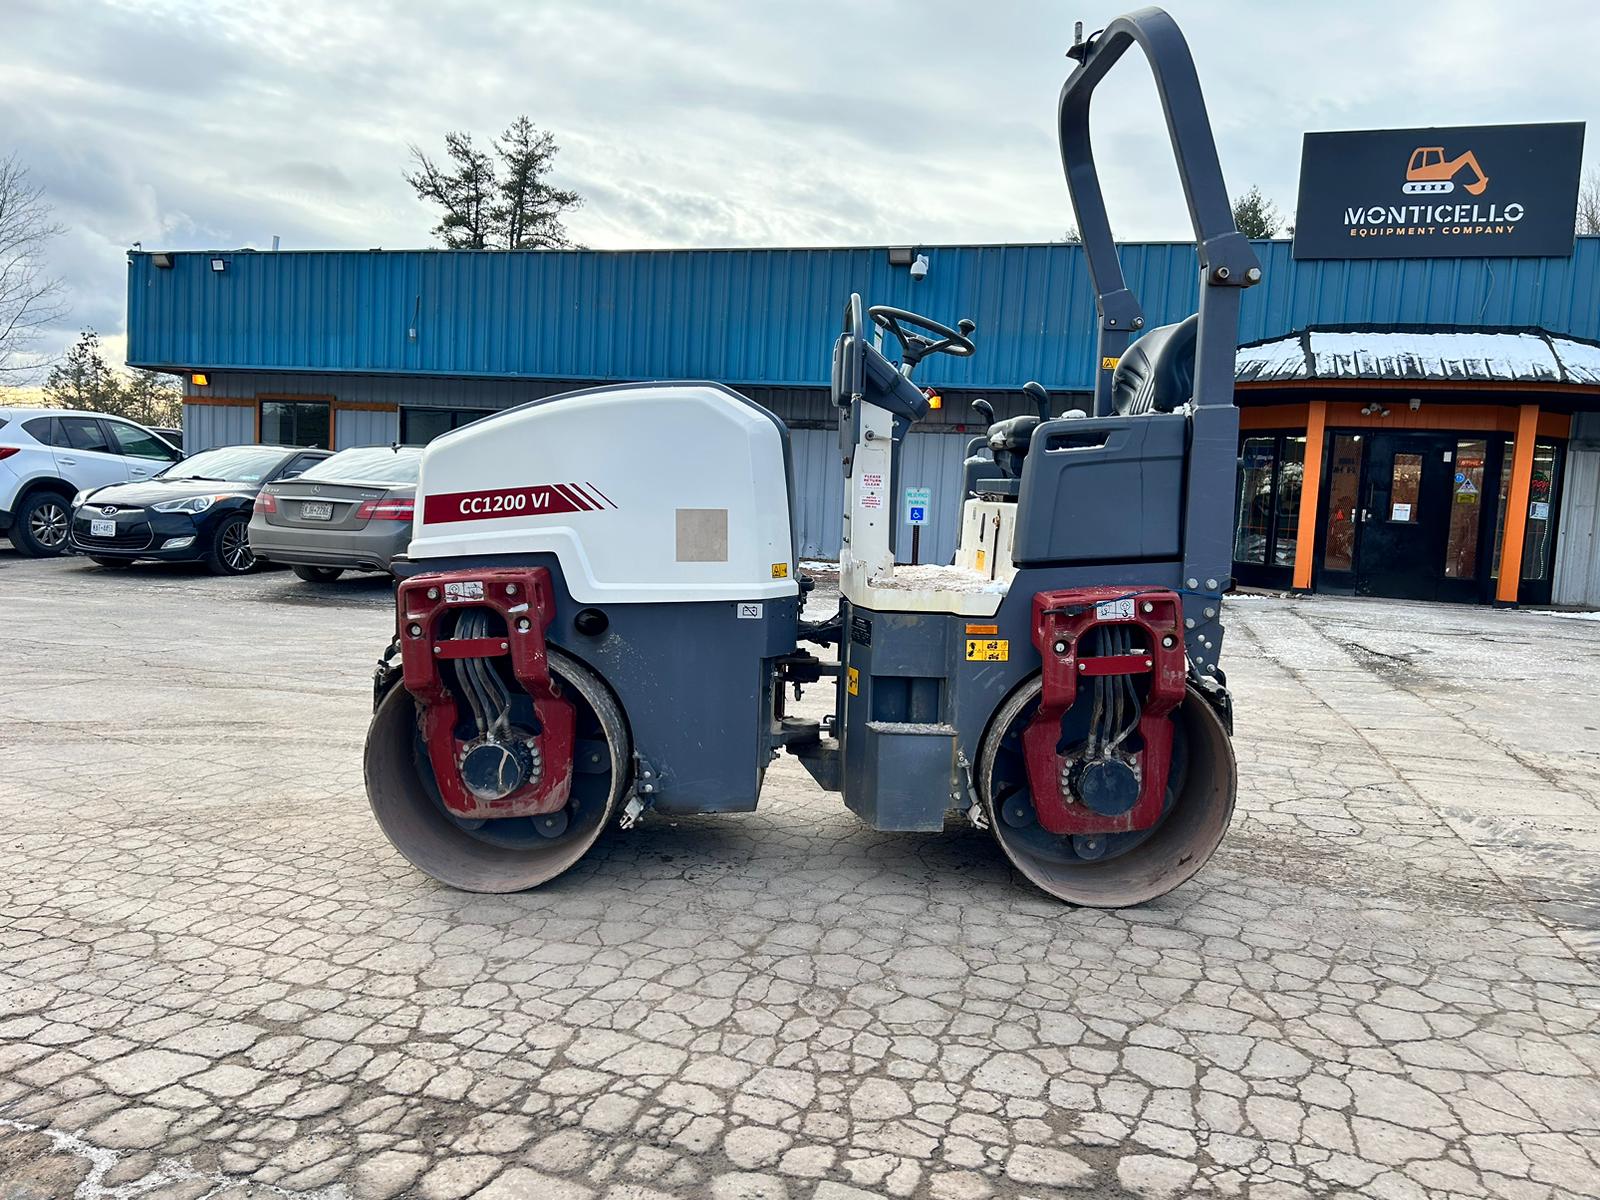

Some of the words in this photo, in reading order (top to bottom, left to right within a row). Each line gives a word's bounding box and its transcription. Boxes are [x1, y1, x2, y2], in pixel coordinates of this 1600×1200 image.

[1344, 203, 1524, 225] MONTICELLO
[1350, 226, 1436, 237] EQUIPMENT
[1442, 225, 1515, 235] COMPANY
[459, 493, 526, 515] CC1200
[531, 492, 550, 508] VI
